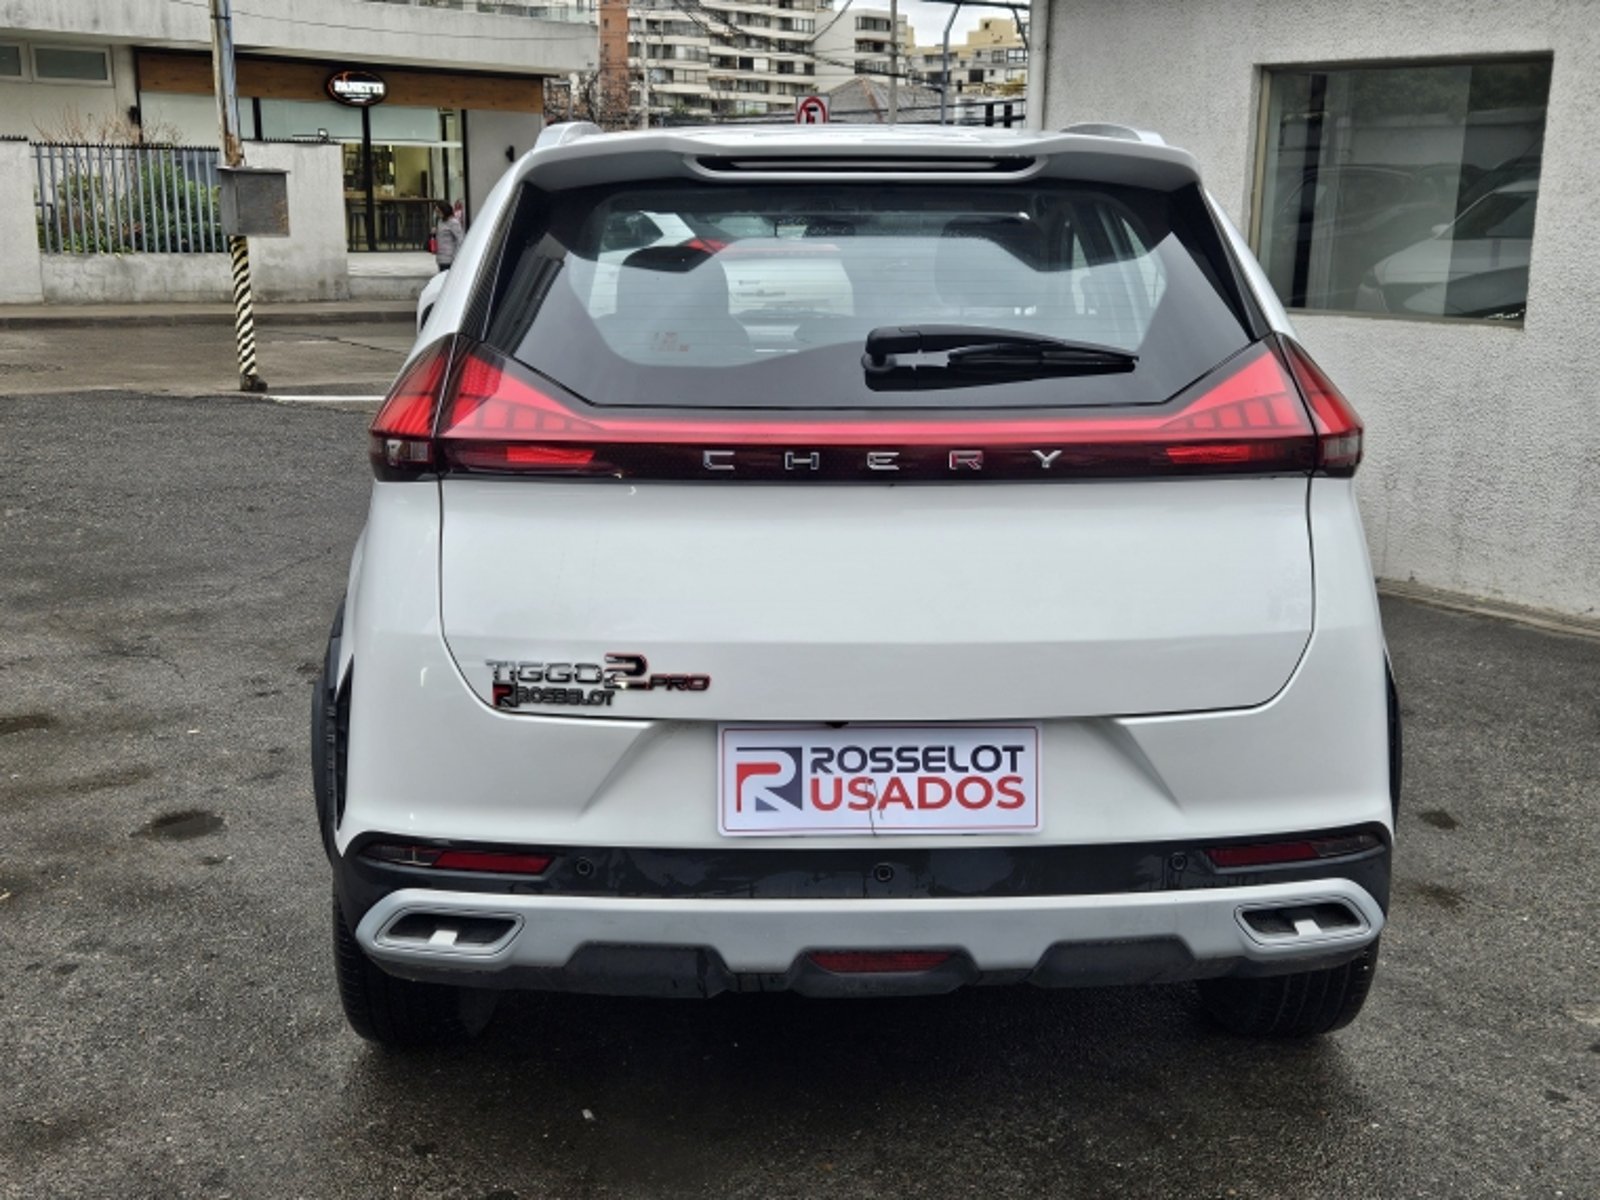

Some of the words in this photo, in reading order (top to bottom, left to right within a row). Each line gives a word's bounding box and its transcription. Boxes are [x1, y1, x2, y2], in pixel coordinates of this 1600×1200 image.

[703, 450, 1062, 471] CHERY
[485, 659, 603, 684] TIGGO
[648, 673, 711, 692] PRO
[810, 745, 1026, 774] ROSSELOT
[810, 776, 1027, 811] USADOS
